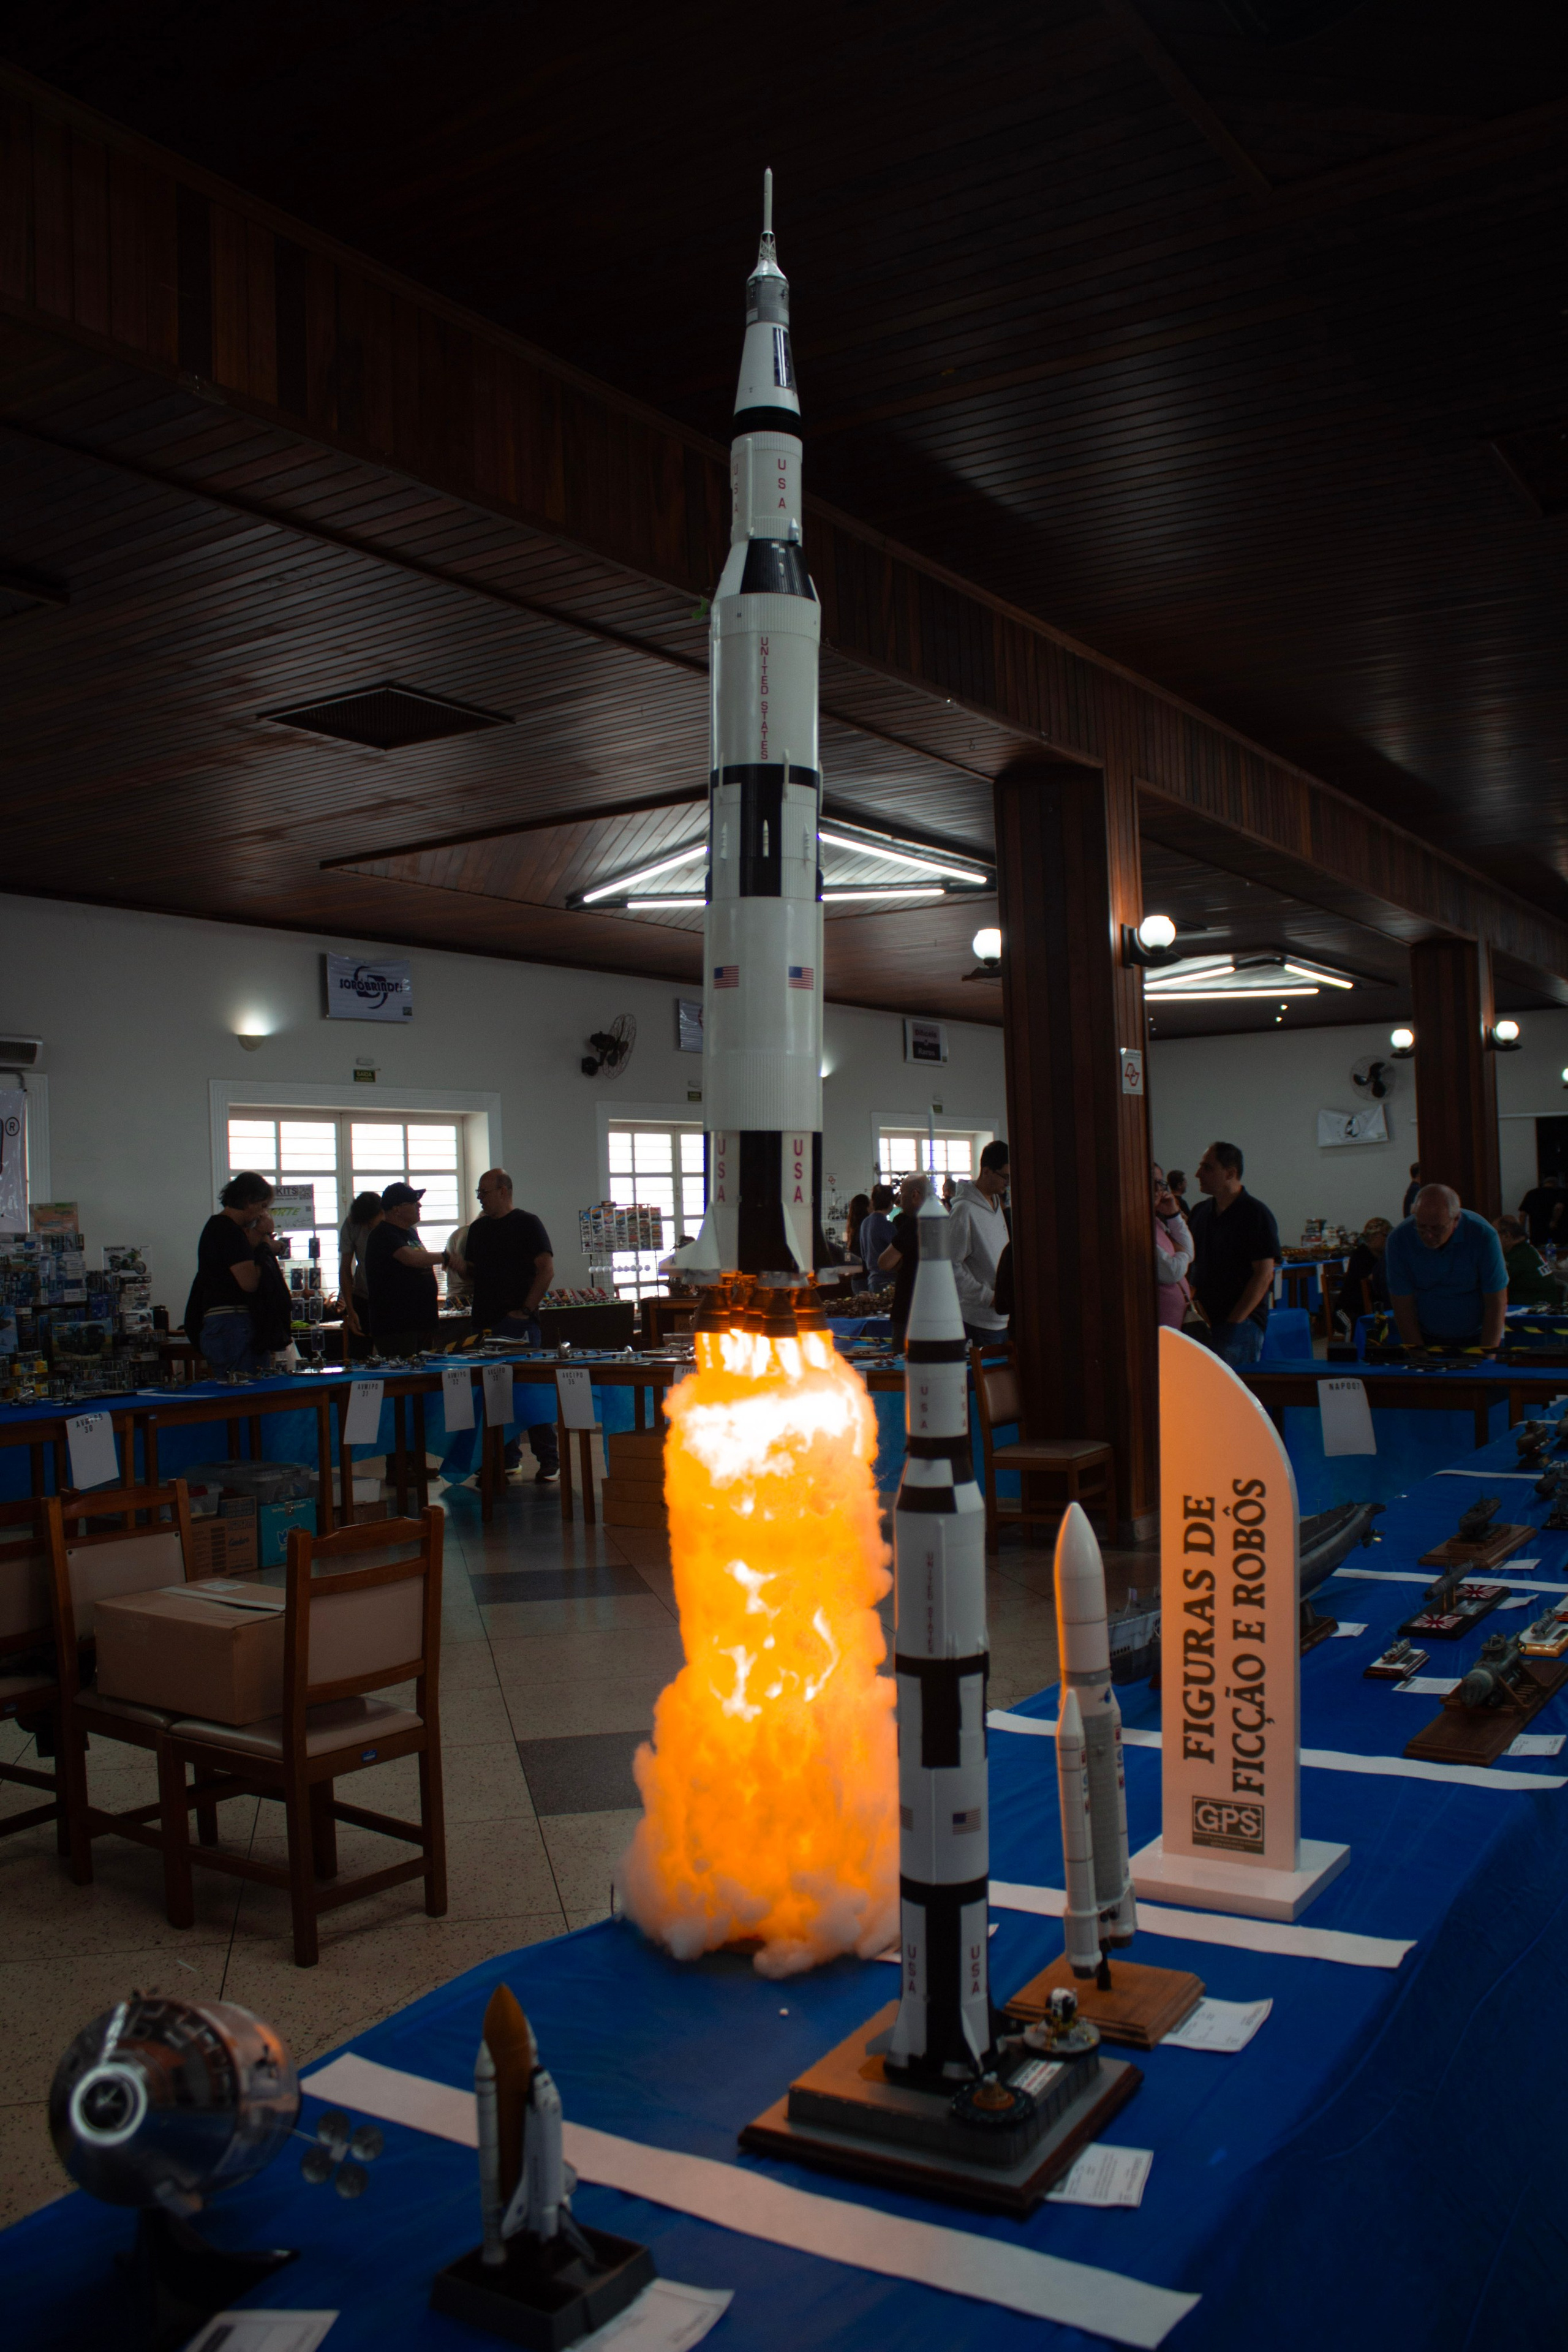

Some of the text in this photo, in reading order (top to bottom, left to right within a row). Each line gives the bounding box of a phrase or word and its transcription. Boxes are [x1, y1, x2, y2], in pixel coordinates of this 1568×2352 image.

[777, 458, 786, 509] USA
[760, 636, 769, 695] UNITED
[717, 1139, 726, 1202] USA
[794, 1139, 803, 1203] USA
[1223, 1479, 1267, 1610] ROBÔS
[1183, 1494, 1216, 1763] FIGURAS DE
[1233, 1619, 1265, 1643] E
[1225, 1653, 1275, 1796] FICÇÃO
[1197, 1804, 1259, 1836] GPS
[908, 1944, 916, 1994] USA
[971, 1945, 980, 1995] USA
